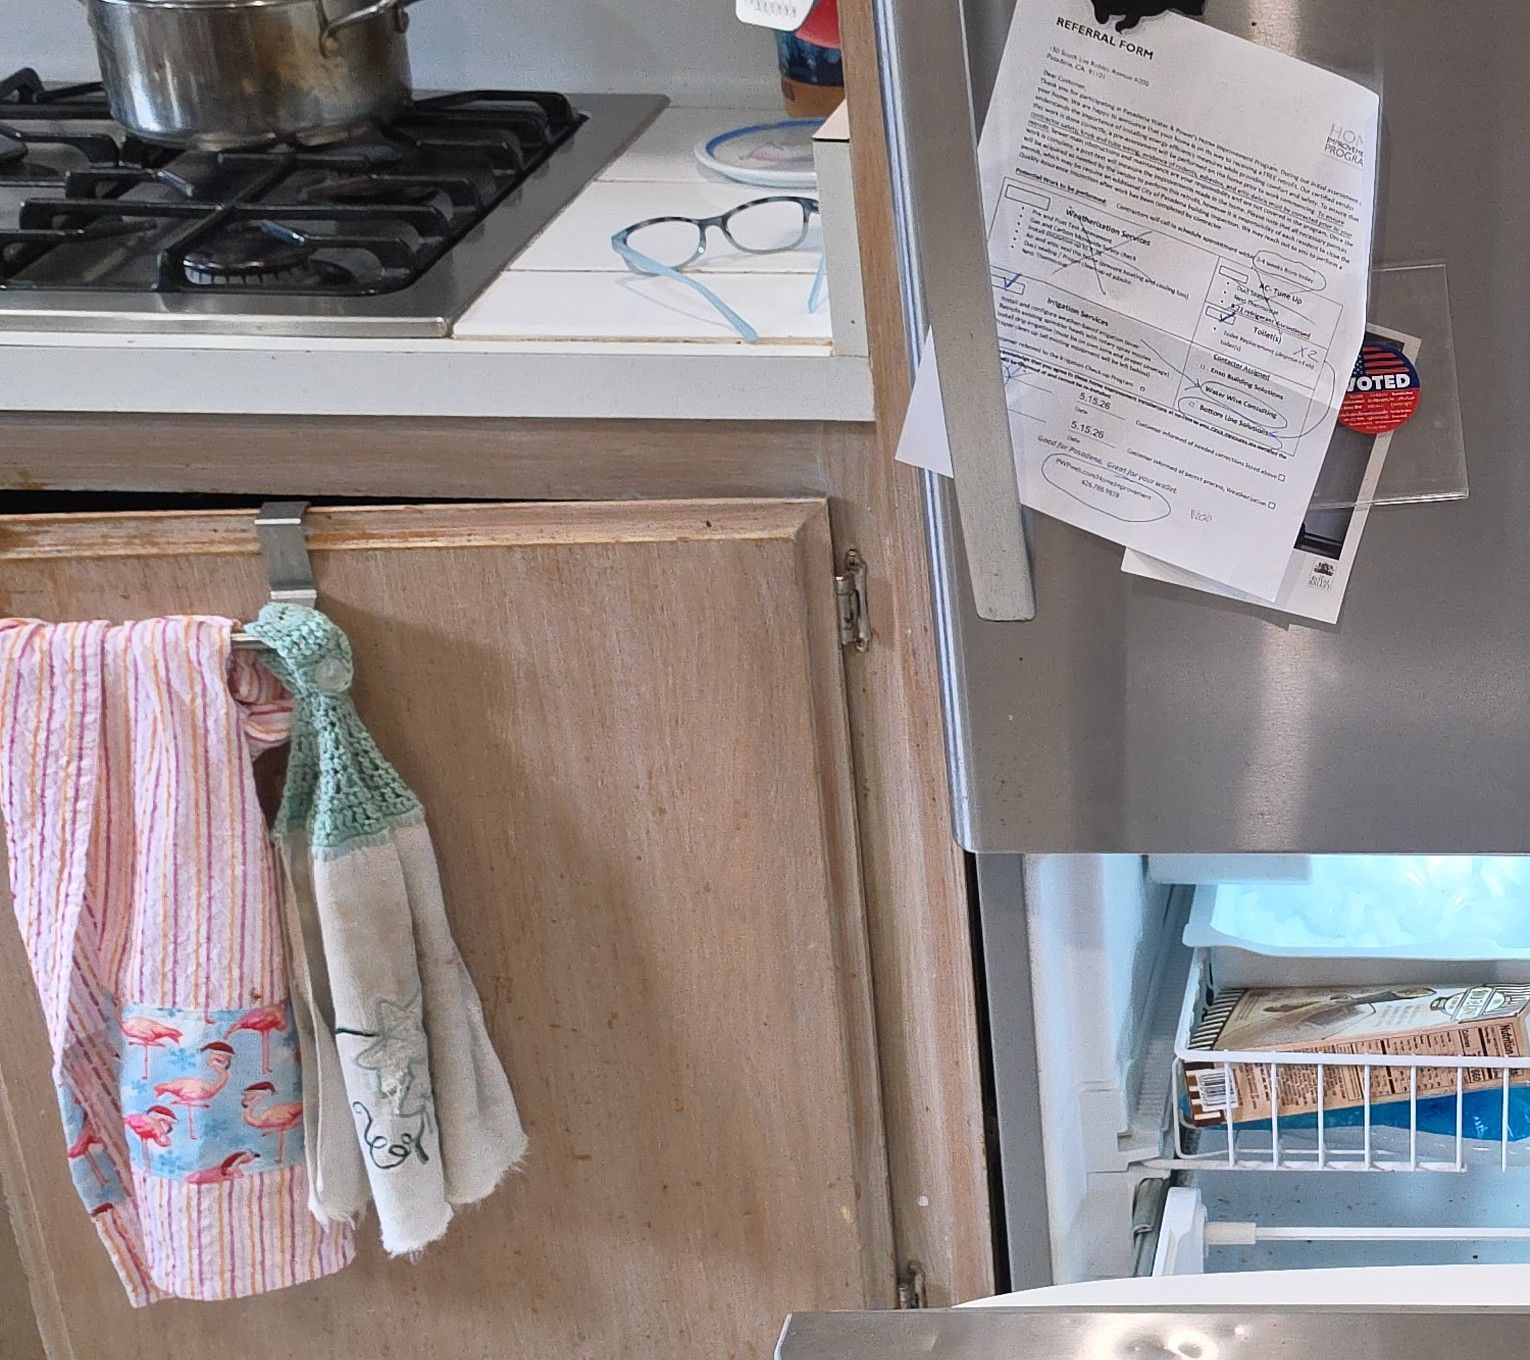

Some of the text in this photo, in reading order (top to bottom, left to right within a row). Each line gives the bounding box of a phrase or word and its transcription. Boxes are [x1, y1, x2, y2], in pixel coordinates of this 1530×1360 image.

[1056, 16, 1154, 60] REFERRAL FORM
[1347, 373, 1411, 392] VOTED
[1079, 392, 1111, 411] 5.15.26
[1070, 421, 1105, 440] 5.15.26
